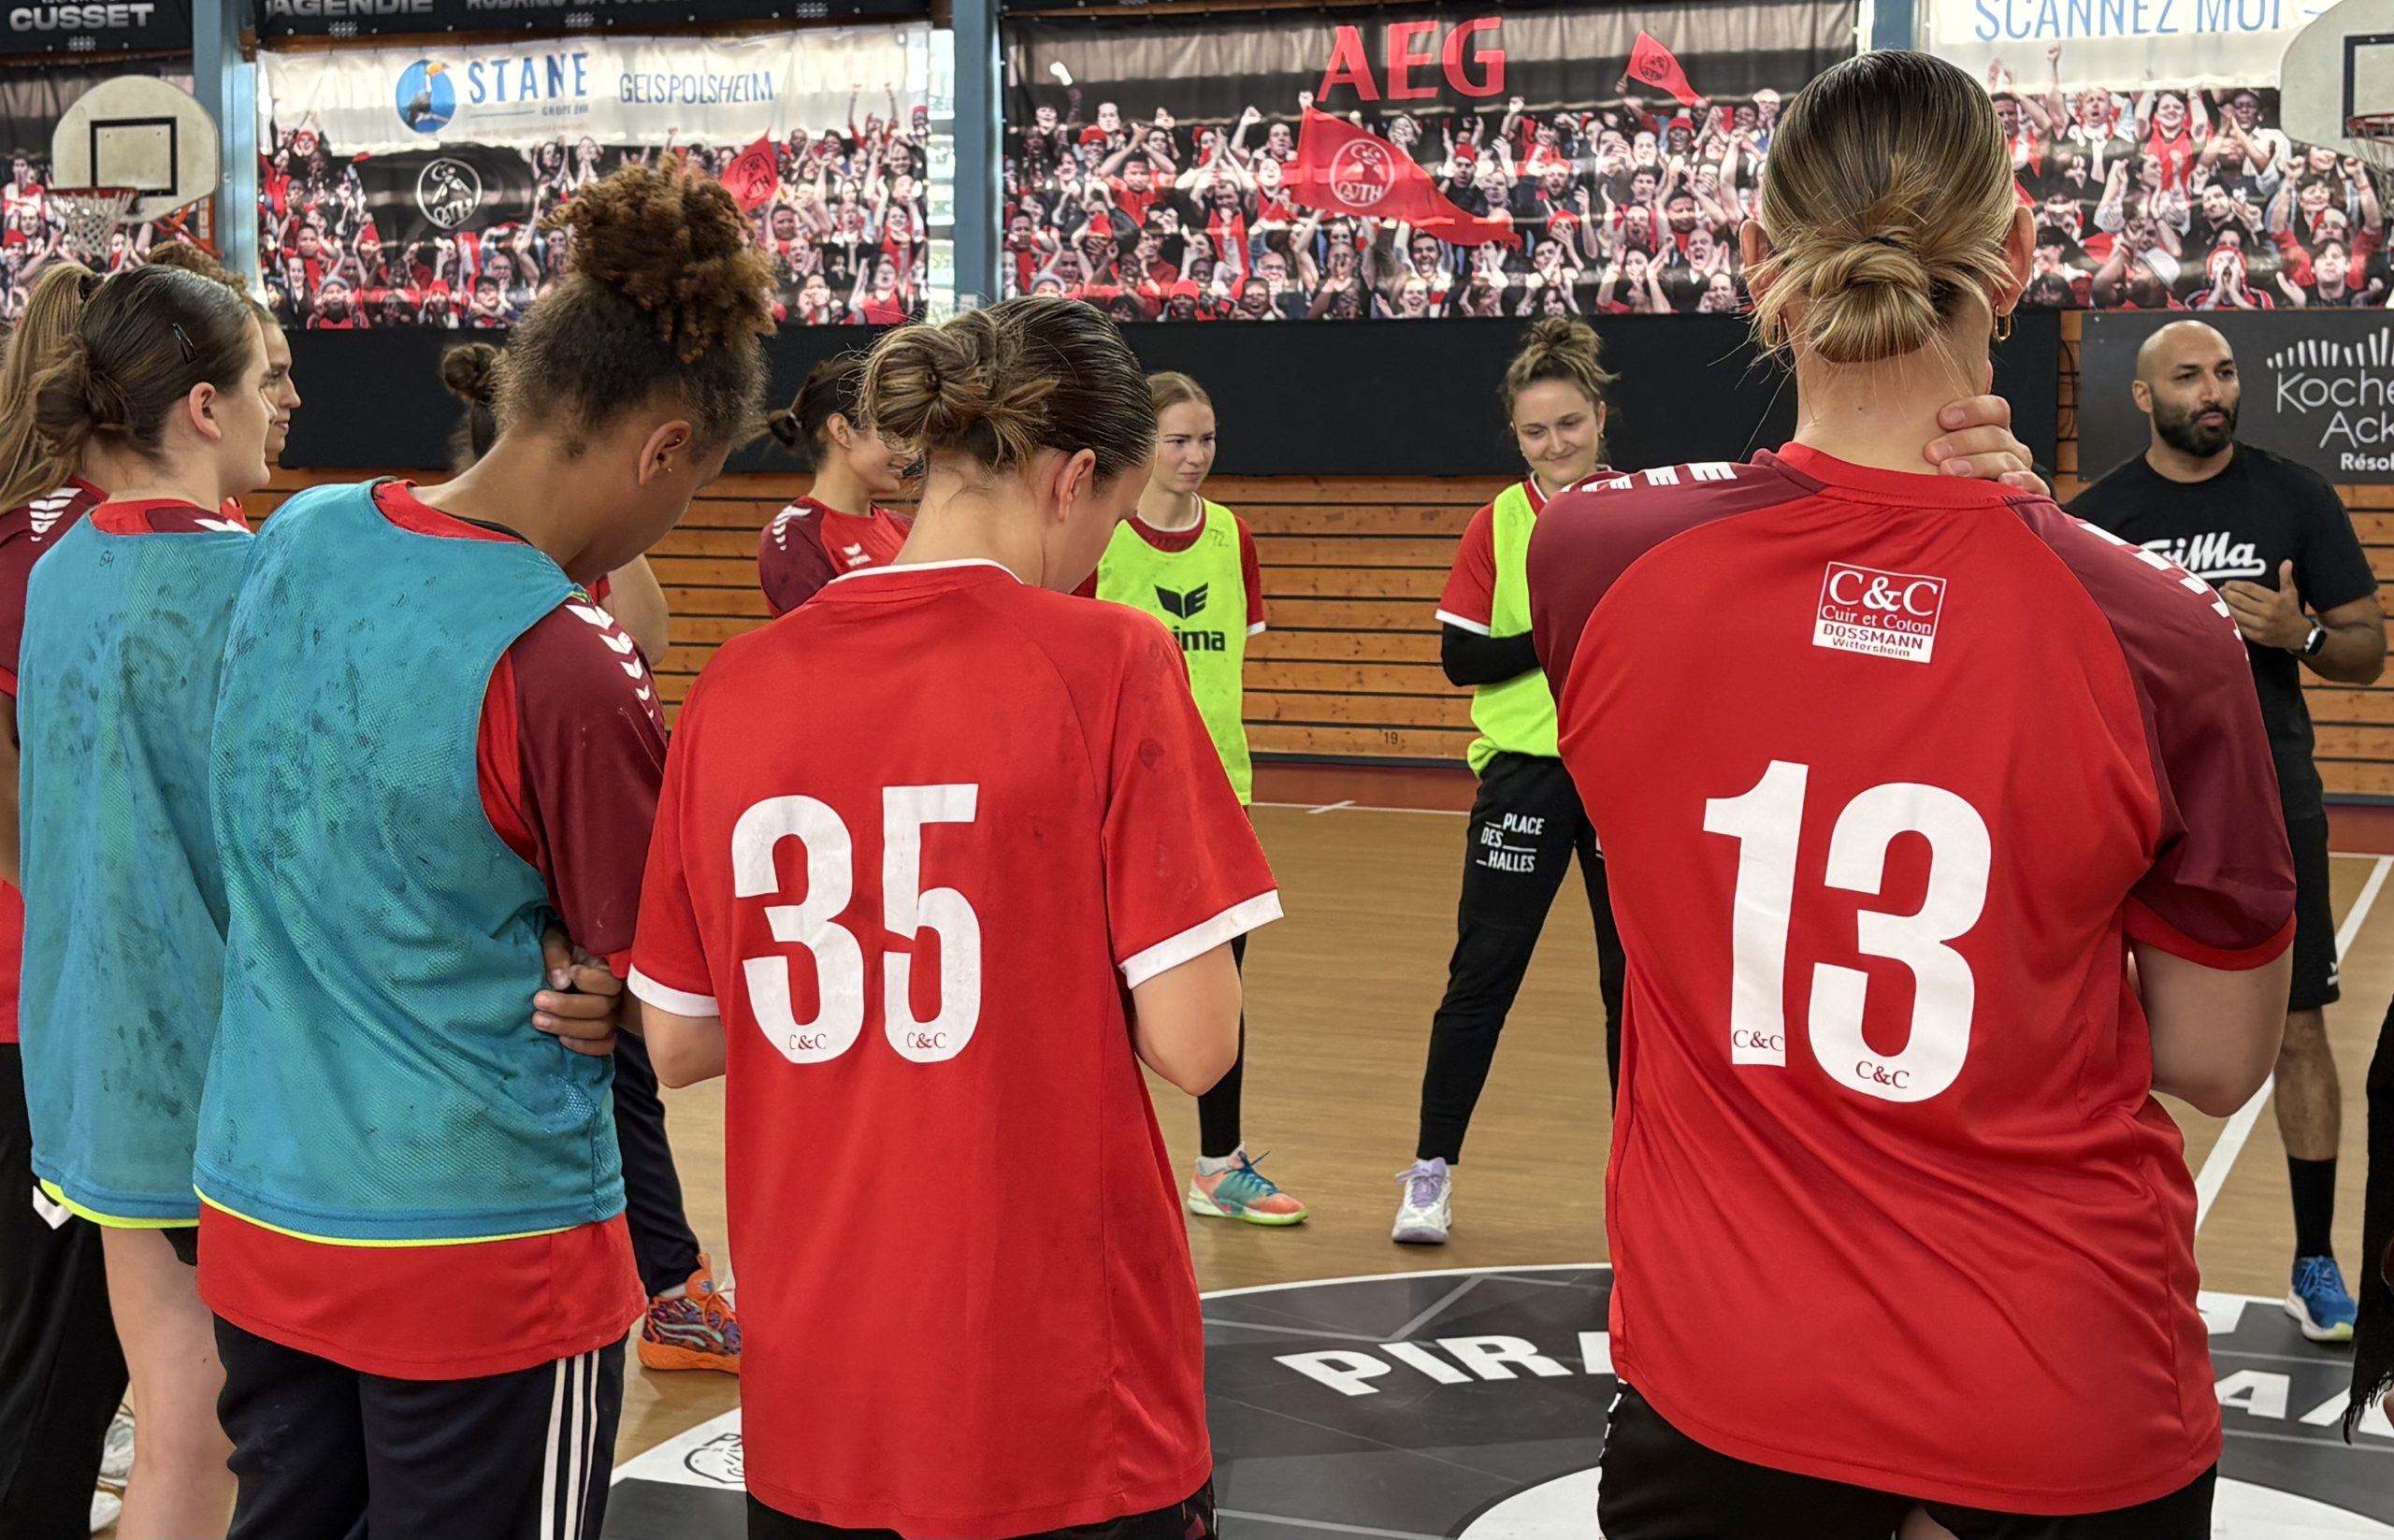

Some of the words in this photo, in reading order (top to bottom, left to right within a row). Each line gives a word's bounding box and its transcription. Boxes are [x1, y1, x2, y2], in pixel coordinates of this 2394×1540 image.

[9, 3, 154, 32] CUSSET
[1975, 0, 2179, 41] SCANNEZ
[2197, 0, 2280, 32] MOI
[1317, 17, 1505, 102] AEG
[469, 52, 588, 104] STANE
[620, 71, 773, 104] GEISPOLSHEIM
[1829, 570, 1938, 616] C&C
[1822, 605, 1857, 624] Cuir
[1862, 613, 1878, 626] et
[1883, 614, 1932, 635] Coton
[1824, 624, 1924, 650] DOSSMANN
[1832, 638, 1911, 657] Wittersheim
[1384, 731, 1398, 744] 19
[1480, 827, 1504, 848] DES
[1503, 813, 1545, 835] PLACE
[1488, 850, 1536, 872] HALLES
[731, 784, 981, 1063] 35
[1703, 759, 1992, 1102] 13
[789, 1033, 827, 1050] C&C
[906, 1031, 946, 1049] C&C
[1733, 1029, 1783, 1052] C&C
[1855, 1060, 1910, 1089] C&C
